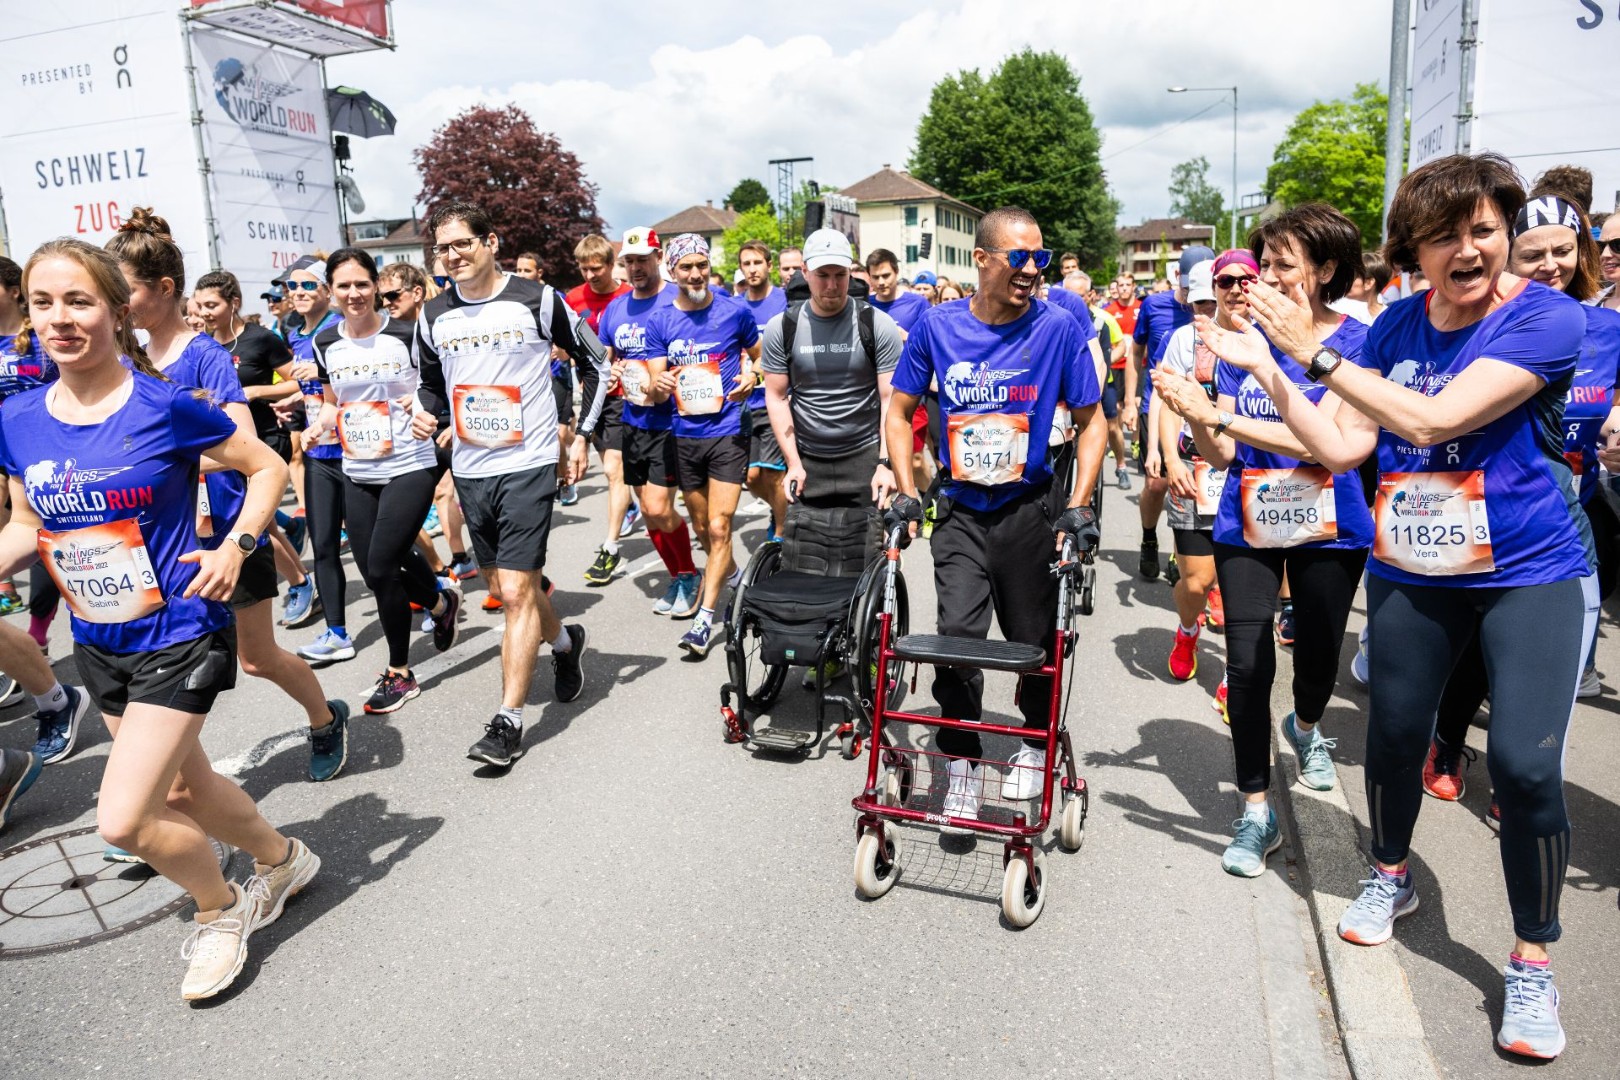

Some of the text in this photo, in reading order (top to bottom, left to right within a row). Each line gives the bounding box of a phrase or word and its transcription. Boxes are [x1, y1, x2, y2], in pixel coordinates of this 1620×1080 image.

[22, 64, 91, 86] PRESENTED
[79, 82, 93, 95] BY
[233, 96, 316, 134] WORLD RUN
[35, 148, 148, 189] SCHWEIZ
[74, 201, 121, 233] ZUG
[248, 221, 314, 243] SCHWEIZ
[621, 336, 646, 349] WORL
[971, 370, 1006, 380] WINGS
[681, 387, 713, 401] 55782
[958, 384, 1038, 402] WORLD RUN
[1573, 386, 1607, 403] RUN
[1246, 397, 1279, 416] WOR
[465, 416, 521, 431] 35063 2
[346, 429, 380, 443] 28413
[964, 450, 1012, 472] 51471
[52, 470, 98, 484] WINGS
[59, 482, 85, 494] LIFE
[1271, 484, 1300, 493] WINGS
[37, 485, 153, 515] WORLD RUN
[1407, 491, 1440, 503] WINGS
[201, 501, 209, 513] 3
[1411, 501, 1431, 509] LIFE
[57, 515, 104, 524] SWITZERLAND
[1256, 507, 1319, 525] 49458
[1401, 509, 1443, 517] WORLD RUN 2022
[1390, 524, 1488, 546] 11825 3
[66, 548, 101, 560] WINGS
[1413, 548, 1438, 558] Vera
[73, 556, 92, 566] LIFE
[95, 562, 109, 570] 2022
[67, 570, 154, 598] 47064 3
[88, 600, 120, 608] Sabina
